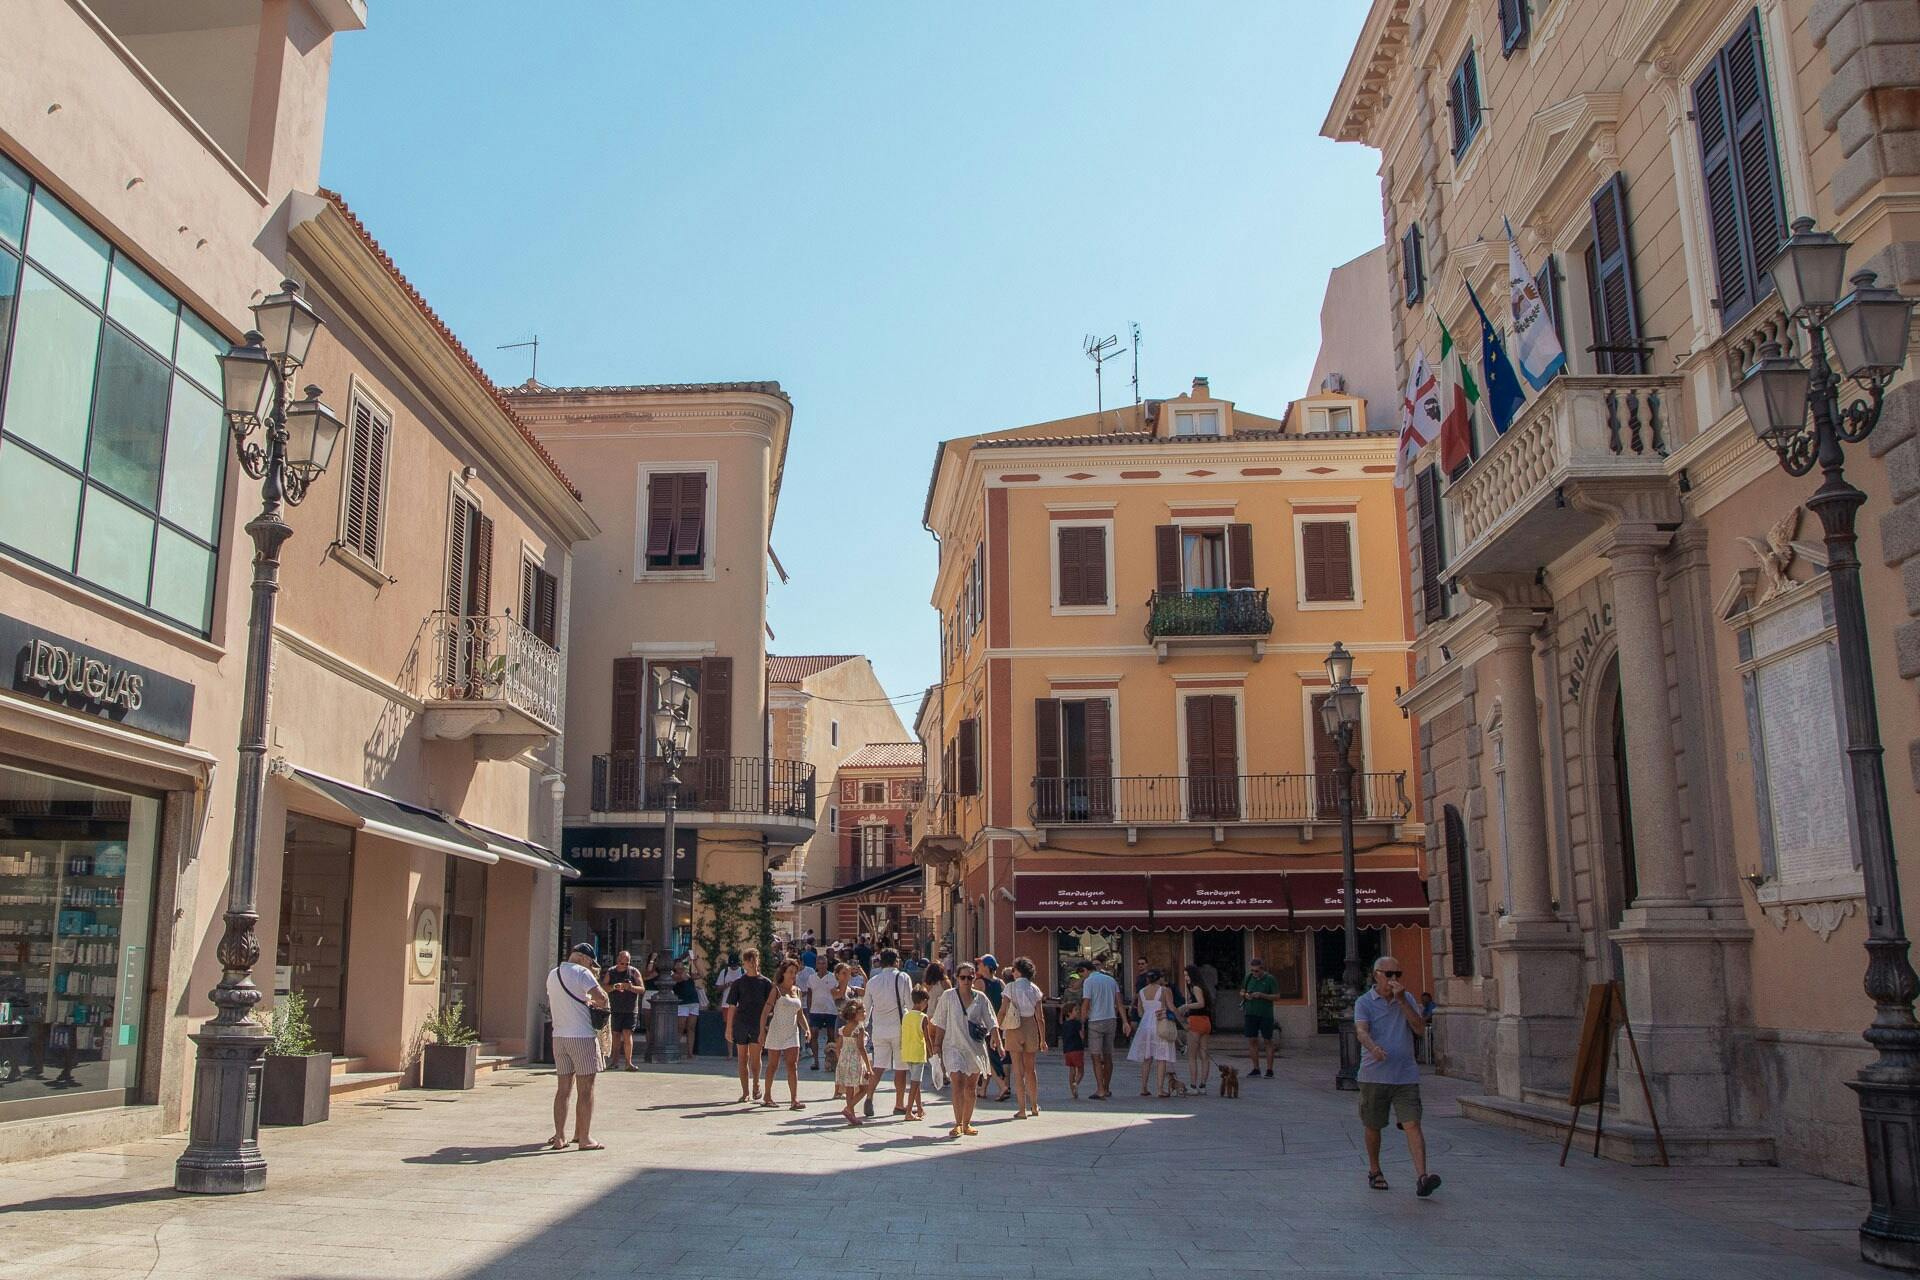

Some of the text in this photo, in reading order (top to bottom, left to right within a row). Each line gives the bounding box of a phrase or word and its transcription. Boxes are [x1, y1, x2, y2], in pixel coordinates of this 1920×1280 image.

[1568, 603, 1612, 701] MUNIC
[28, 638, 144, 711] DOUGLAS
[570, 843, 686, 863] sunglasss
[1057, 890, 1105, 898] Sardaigne
[1196, 889, 1241, 898] Sardegna
[1180, 898, 1226, 907] Mangiare
[1364, 896, 1394, 904] Drink
